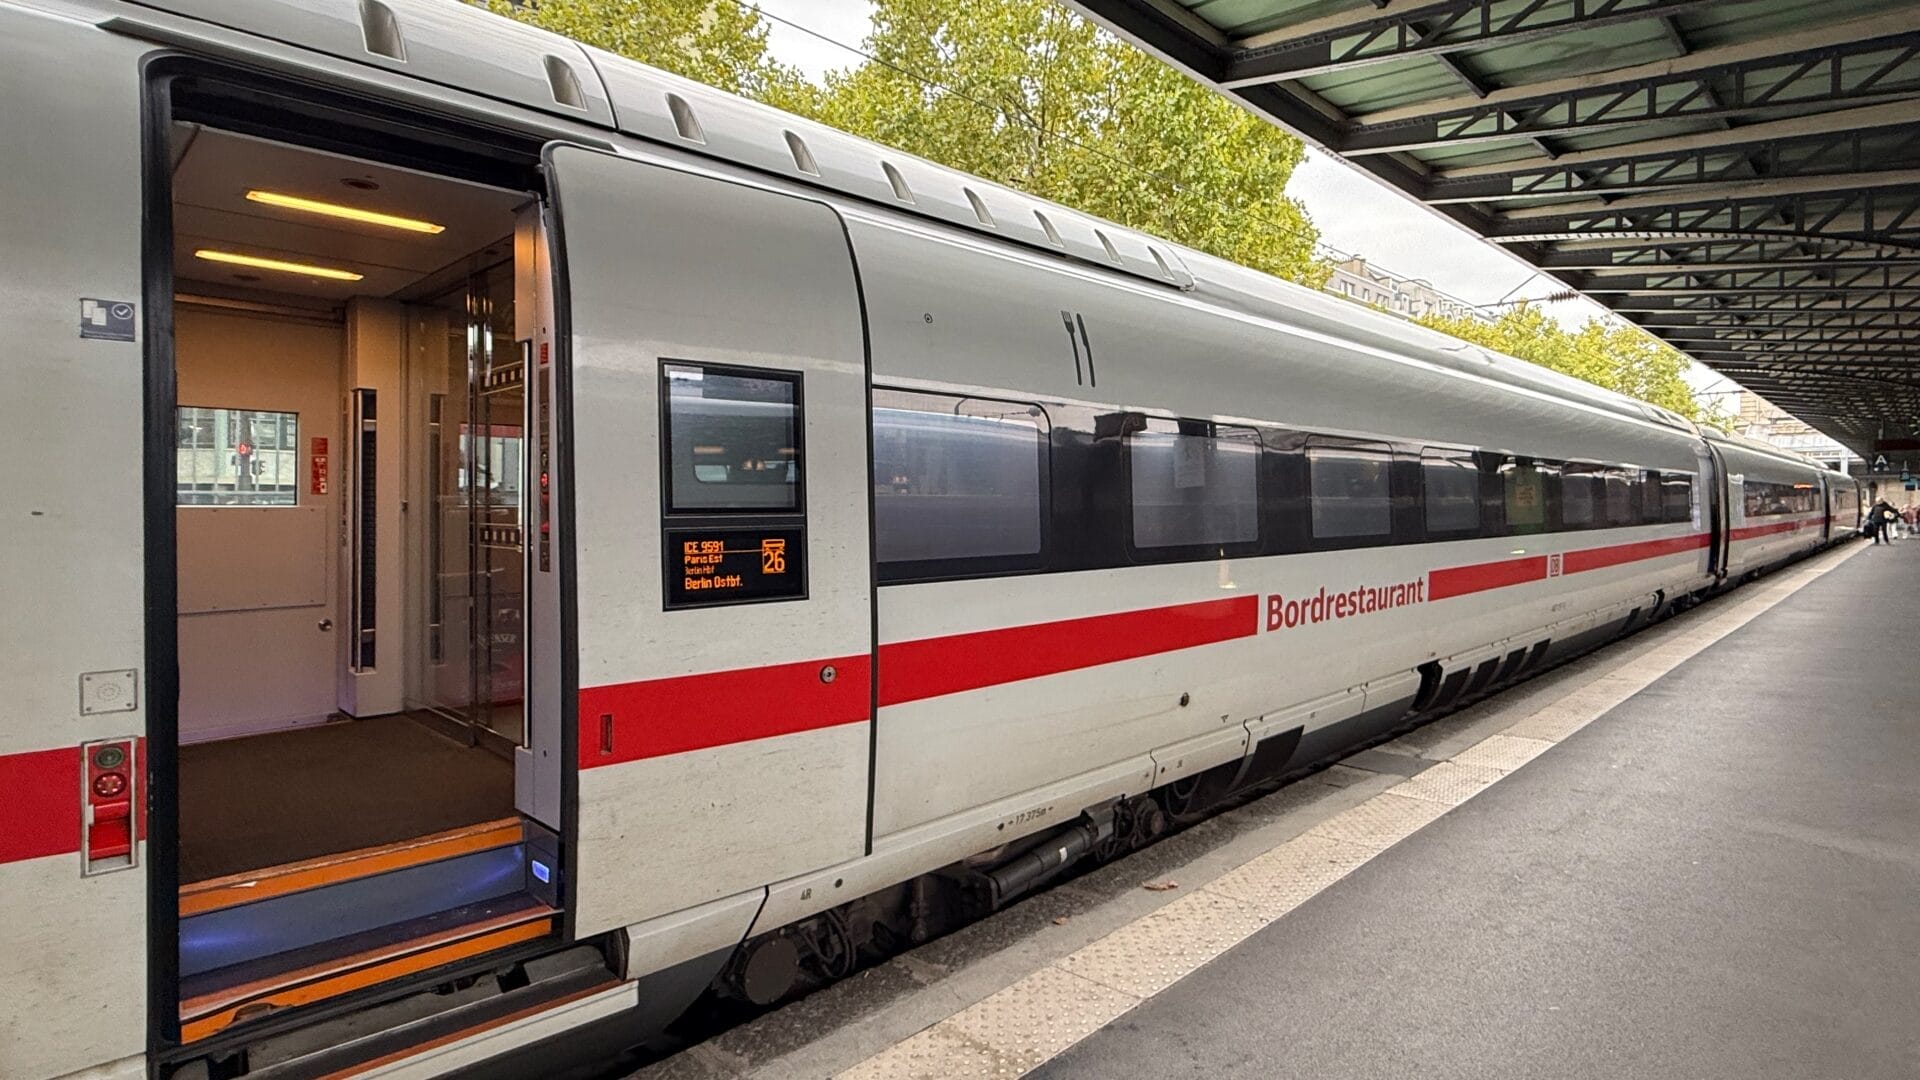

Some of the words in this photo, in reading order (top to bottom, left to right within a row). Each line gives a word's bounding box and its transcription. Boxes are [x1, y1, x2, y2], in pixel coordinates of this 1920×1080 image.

[684, 541, 699, 553] ICE
[701, 540, 724, 553] 9591
[684, 555, 708, 565] Paris
[709, 554, 723, 564] Est
[763, 551, 785, 573] 26
[685, 576, 712, 590] Berlin
[1266, 576, 1424, 632] Bordrestaurant
